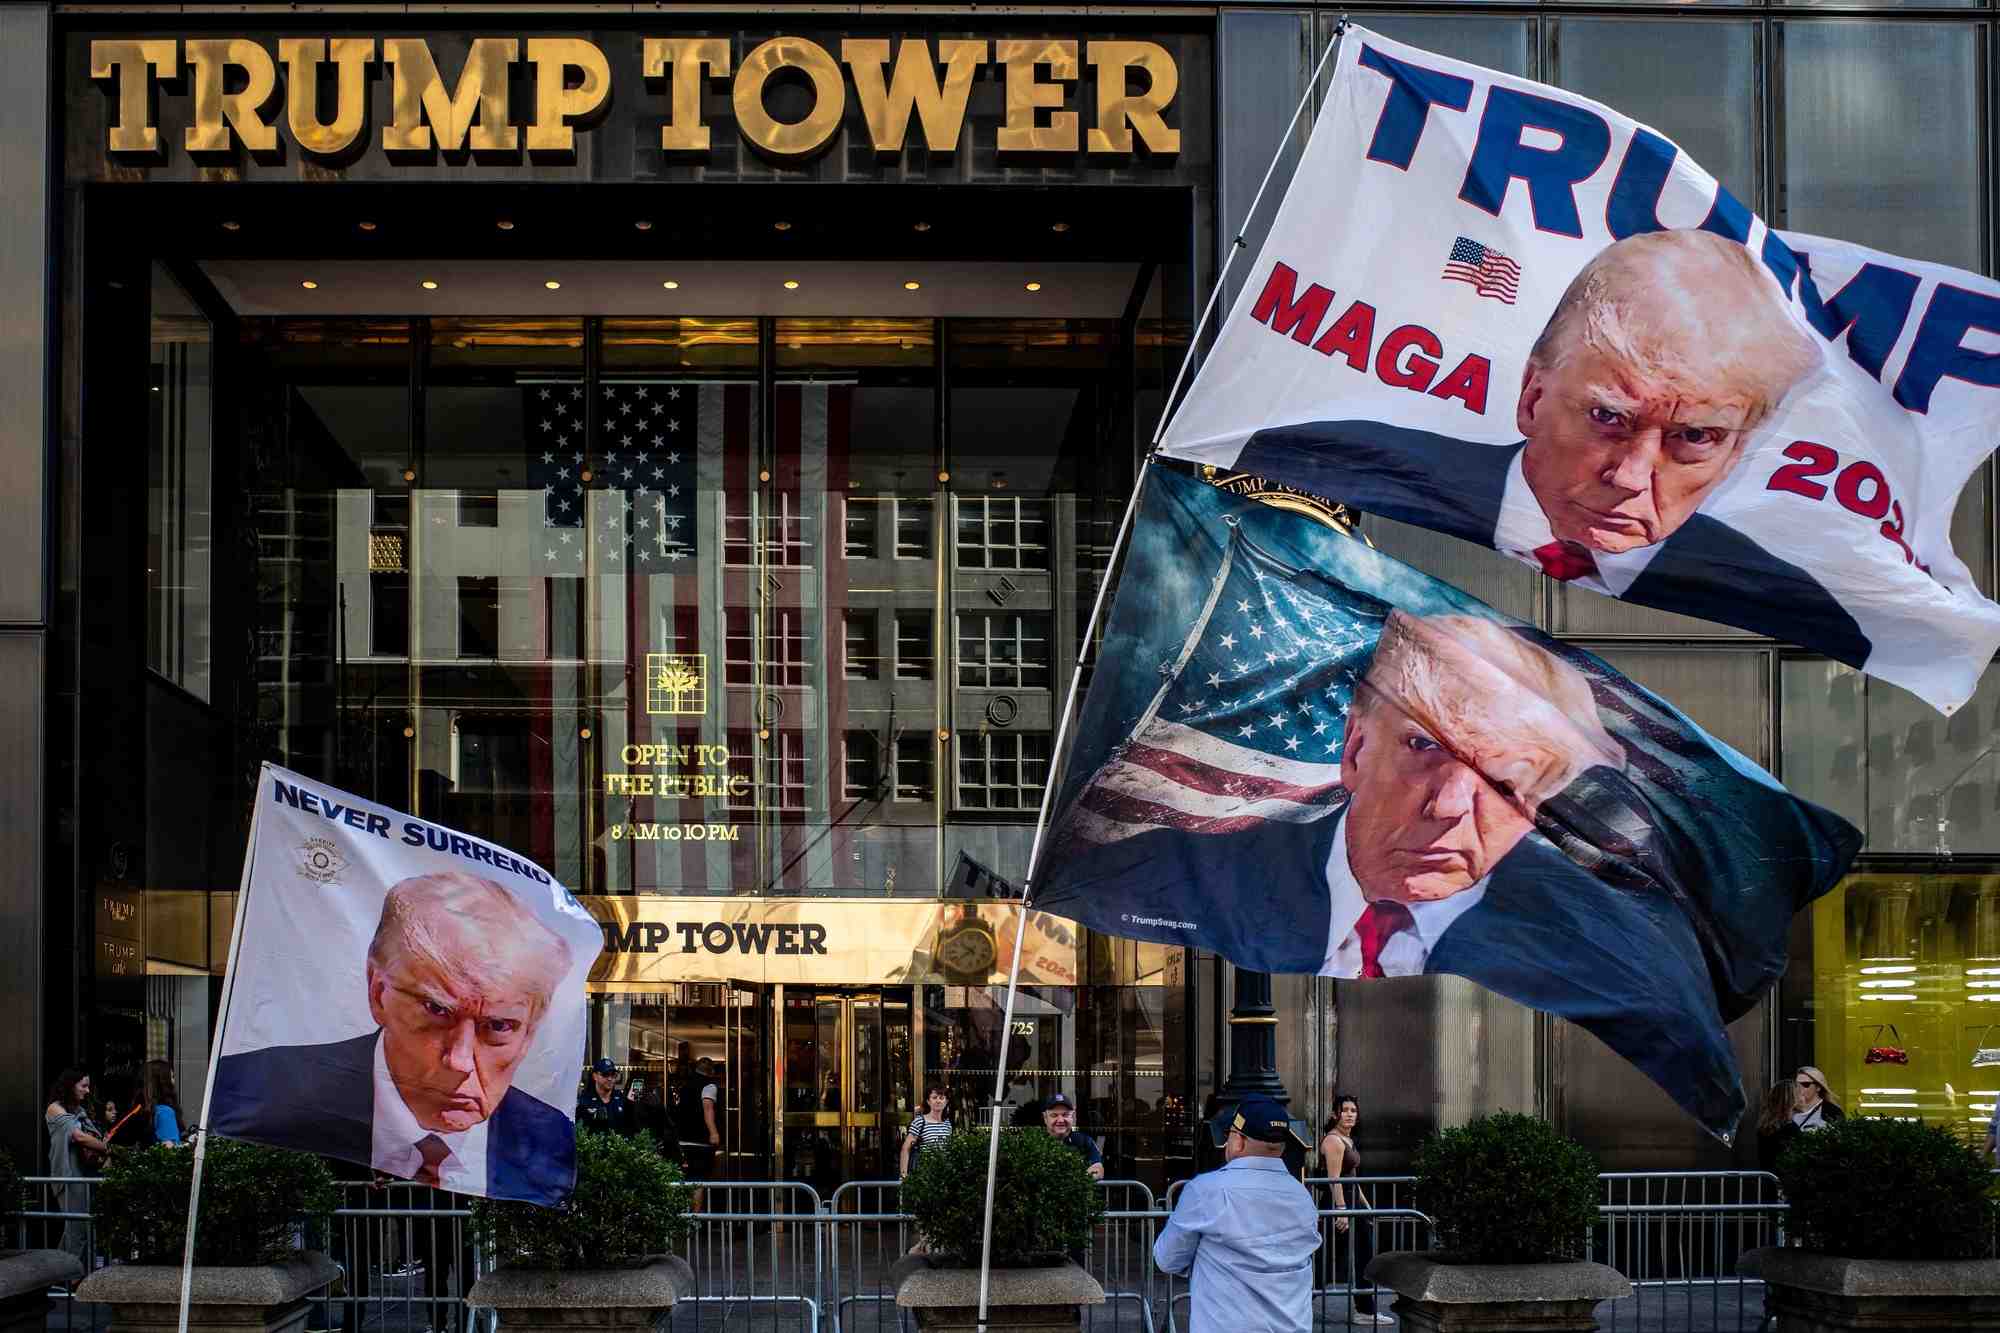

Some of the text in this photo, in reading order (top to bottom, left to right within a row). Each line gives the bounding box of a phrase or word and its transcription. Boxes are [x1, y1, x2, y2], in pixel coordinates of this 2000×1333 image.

[90, 37, 1181, 158] TRUMP TOWER
[1358, 43, 2000, 416] TRUMP
[1251, 261, 1491, 415] MAGA
[621, 744, 730, 766] OPEN TO
[603, 774, 749, 797] THE PUBLIC
[274, 780, 570, 900] NEVER SURREND
[611, 825, 622, 840] 8
[625, 824, 660, 840] AM
[663, 824, 681, 840] to
[708, 824, 739, 840] PM
[600, 922, 828, 955] MP TOWER
[1131, 915, 1198, 930] TrumpSwag.com
